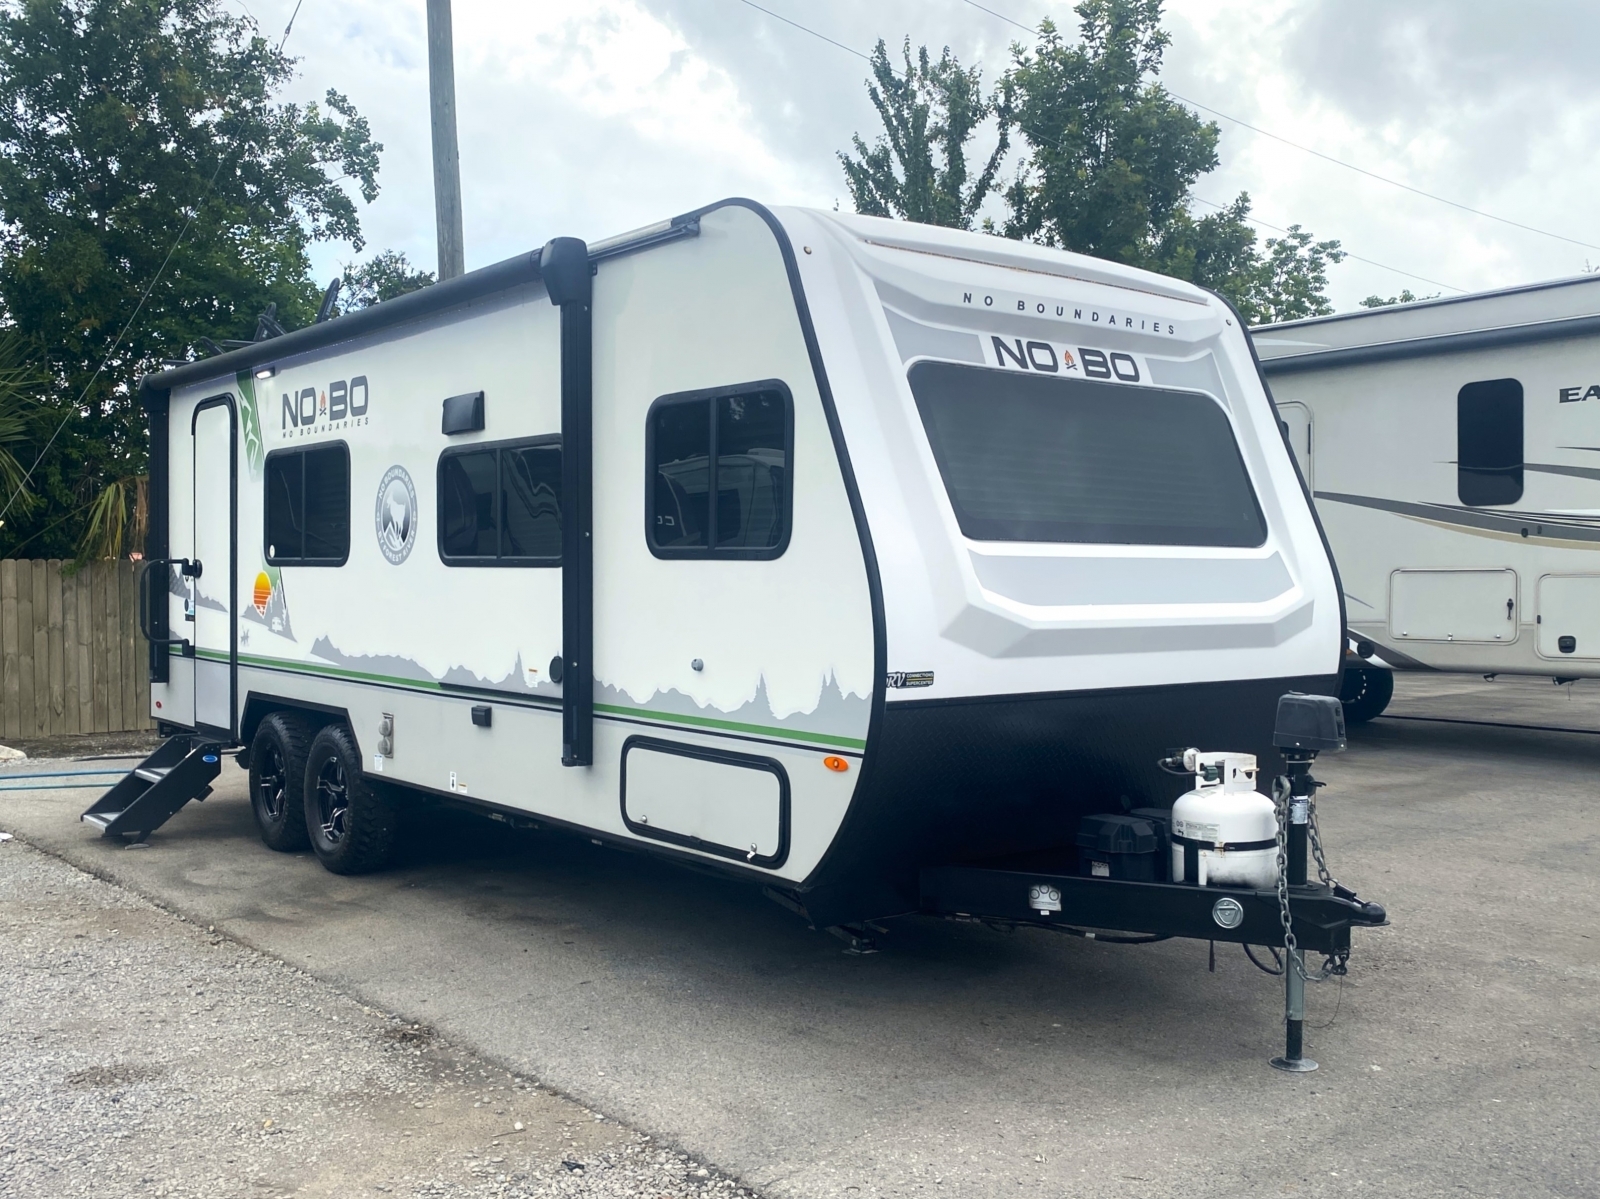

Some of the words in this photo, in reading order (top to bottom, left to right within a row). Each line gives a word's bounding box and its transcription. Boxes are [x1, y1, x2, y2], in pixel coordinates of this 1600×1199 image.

[963, 292, 994, 307] NO
[1017, 300, 1175, 335] BOUNDARIES
[282, 430, 294, 439] NO
[300, 416, 369, 436] BOUNDARIES
[378, 483, 386, 499] NO
[384, 468, 415, 499] BOUNDARIES
[378, 529, 384, 544] BY
[382, 545, 402, 562] FOREST
[402, 529, 415, 558] RIVER
[886, 672, 906, 687] RV
